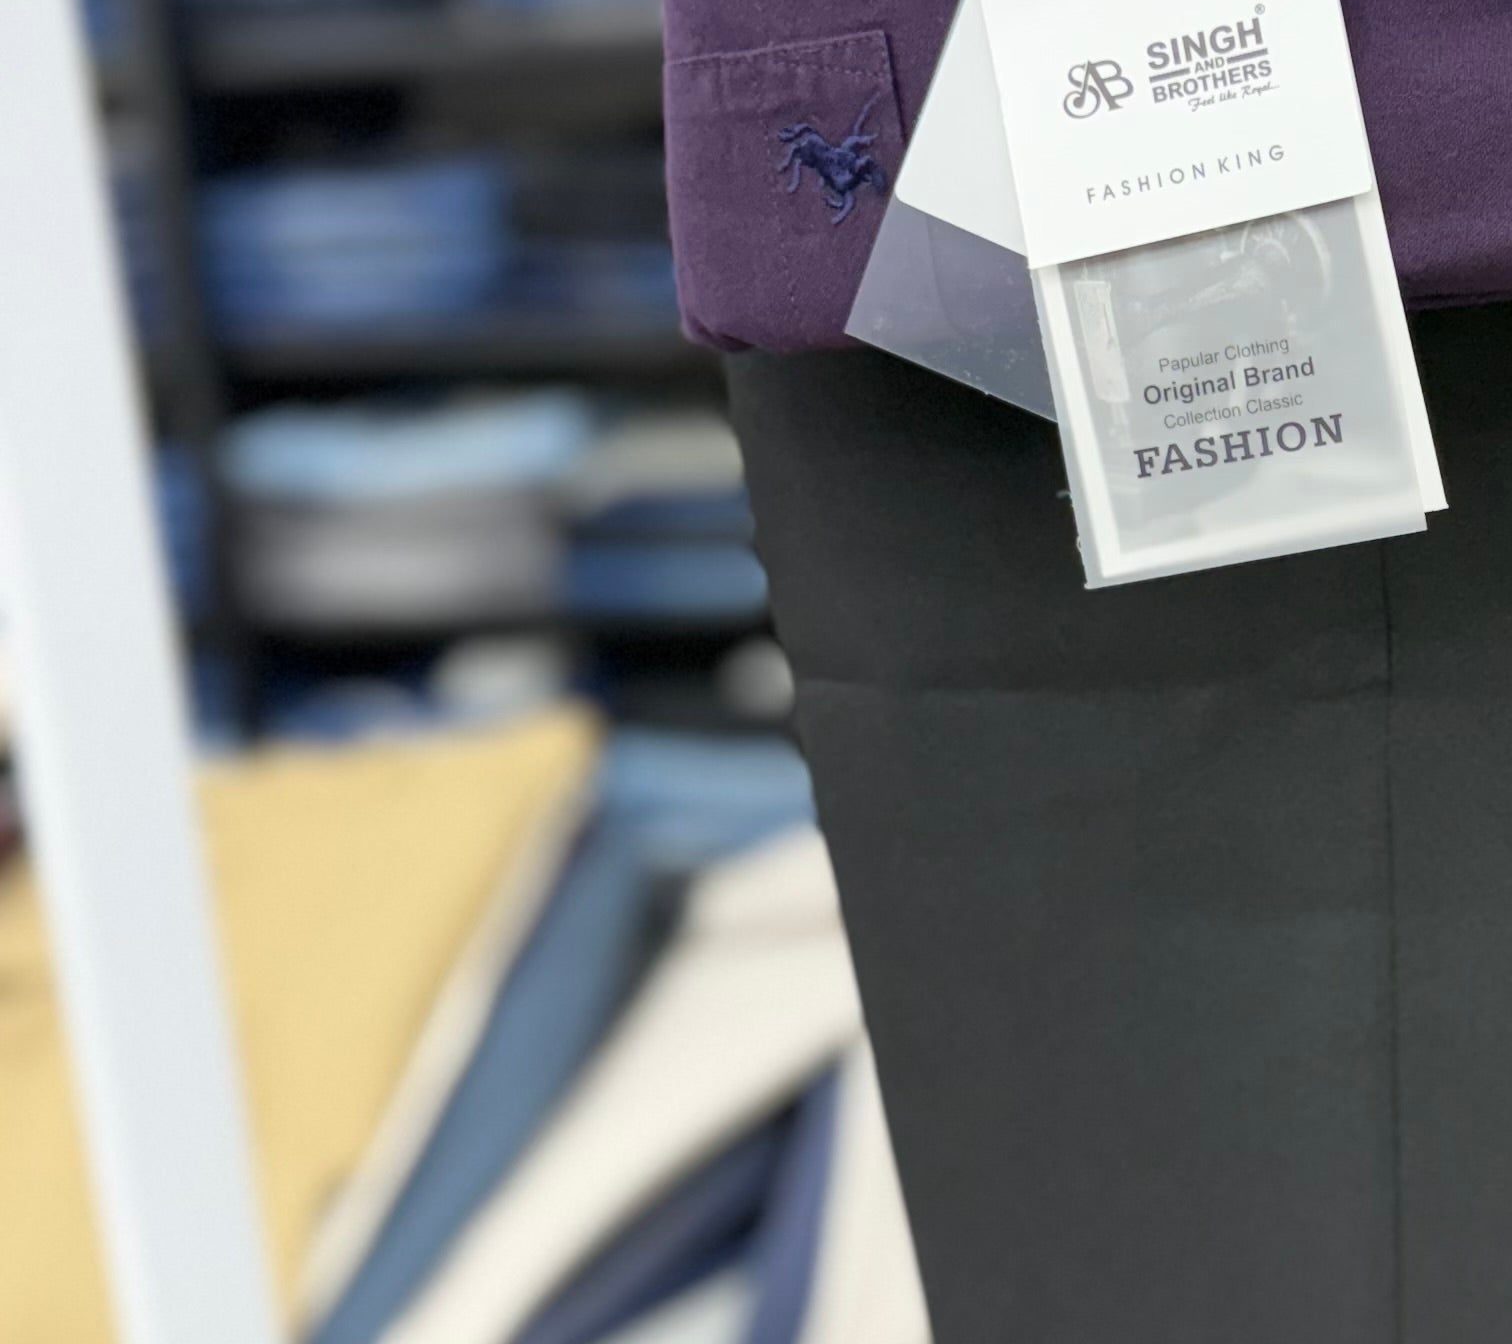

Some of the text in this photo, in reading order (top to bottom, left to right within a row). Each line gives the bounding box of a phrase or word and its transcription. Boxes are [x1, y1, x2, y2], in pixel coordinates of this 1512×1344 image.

[1146, 17, 1264, 71] SINGH
[1194, 56, 1225, 74] AND
[1152, 60, 1272, 104] BROTHERS
[1188, 96, 1215, 112] Feel
[1085, 144, 1286, 204] FASHION KING
[1158, 338, 1289, 373] Papular Clothing
[1143, 356, 1315, 405] Original Brand
[1164, 392, 1303, 429] Collection Classic
[1134, 413, 1344, 479] FASHION
